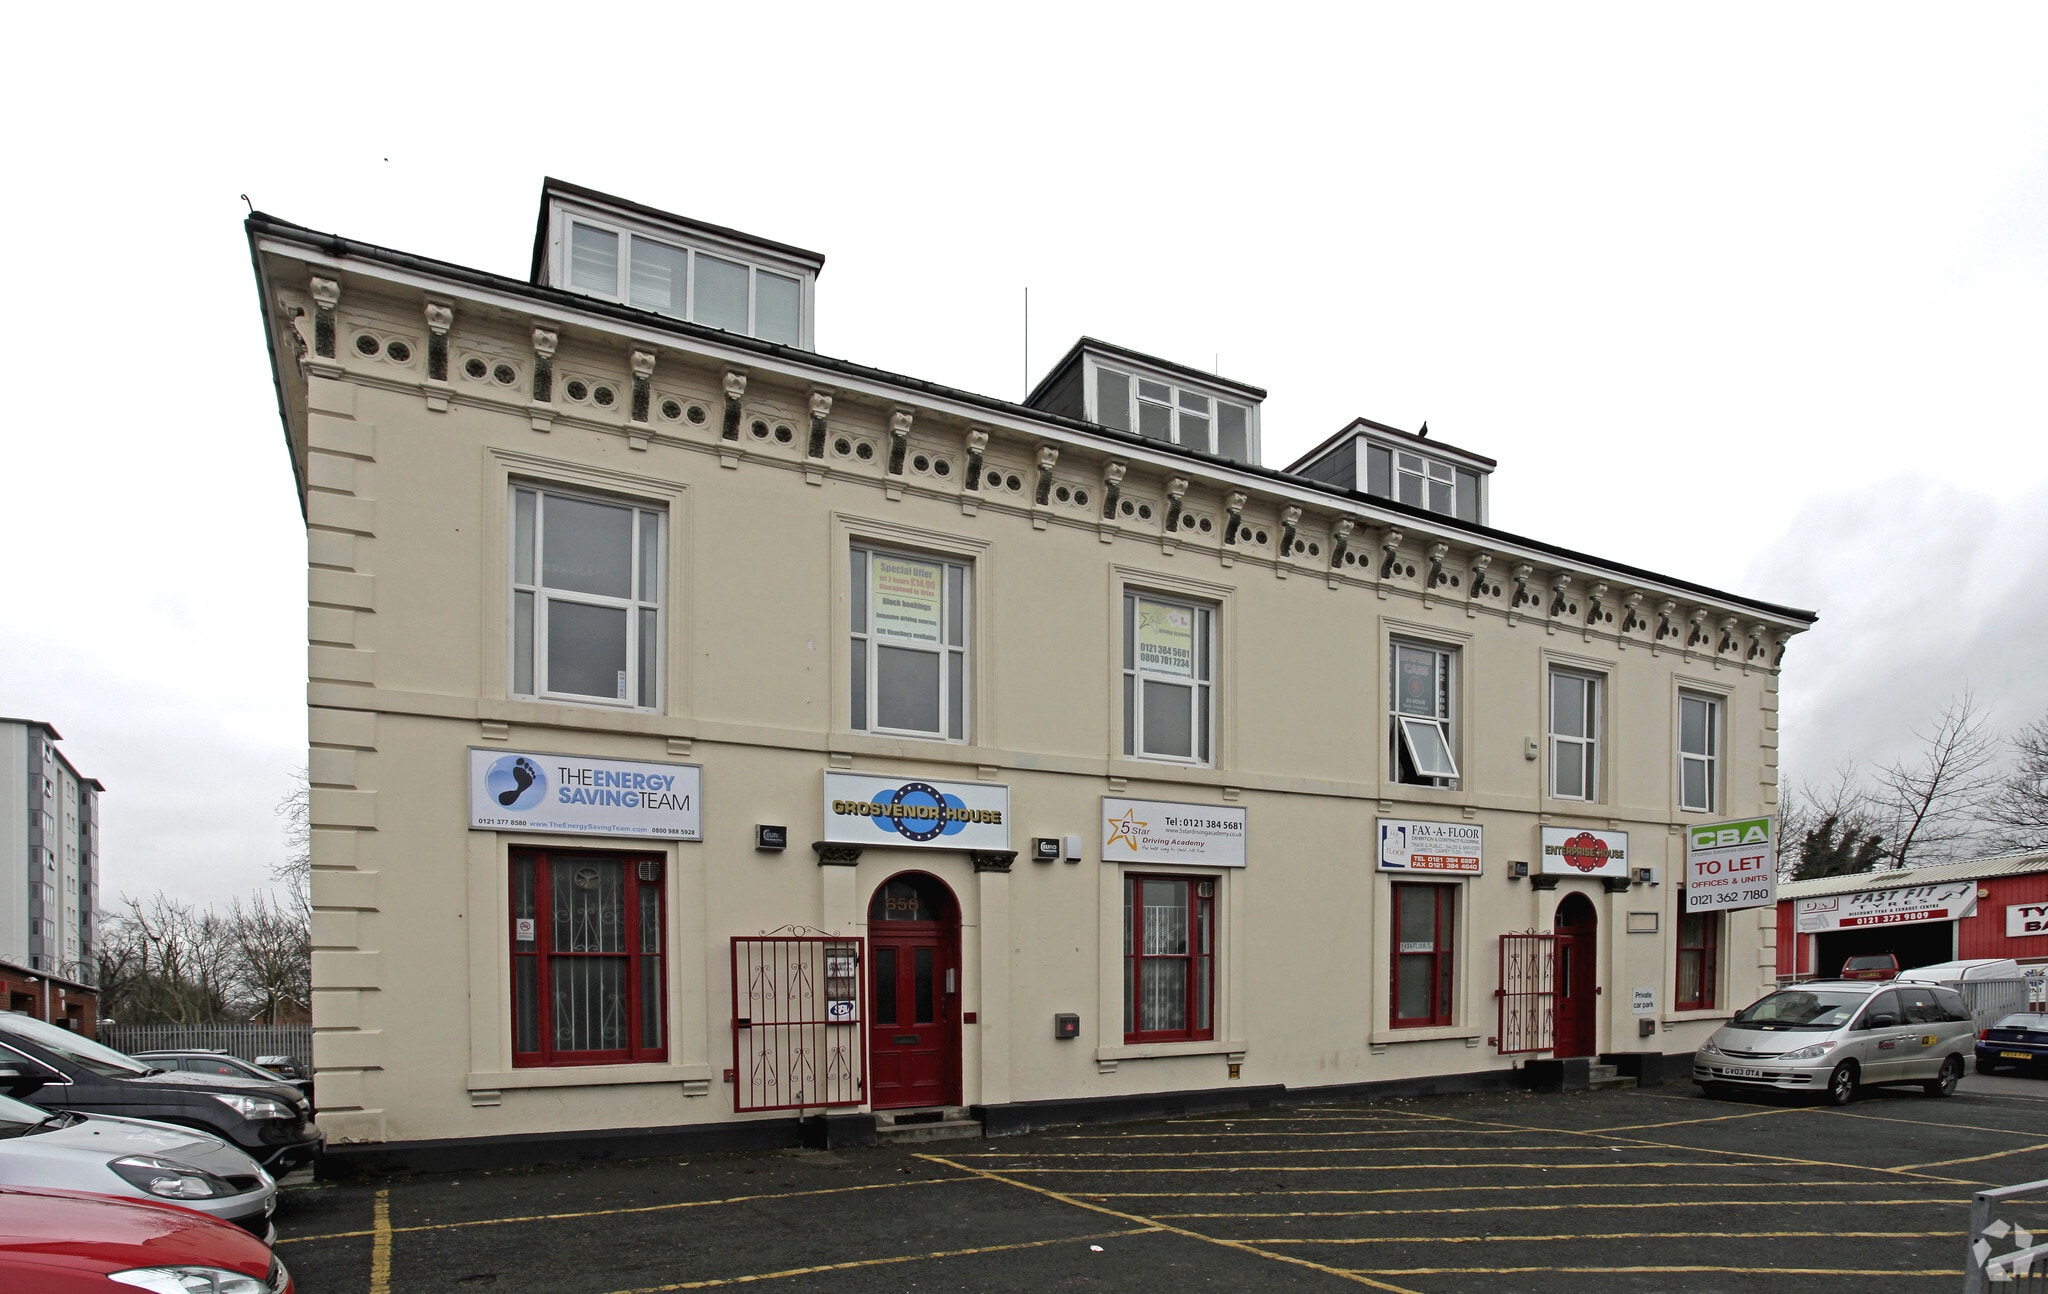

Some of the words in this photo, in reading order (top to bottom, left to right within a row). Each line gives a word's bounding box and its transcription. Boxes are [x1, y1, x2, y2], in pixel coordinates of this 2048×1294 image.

[881, 562, 911, 576] Special
[913, 567, 933, 579] Offer
[1140, 642, 1156, 652] 0121
[1158, 645, 1172, 655] 384
[832, 799, 941, 821] GROSVENOR
[945, 808, 1002, 825] HOUSE
[1120, 821, 1130, 835] 5
[1131, 826, 1151, 836] Star
[1183, 818, 1204, 828] 0121
[1206, 820, 1222, 829] 384
[1223, 821, 1243, 830] 5681
[1412, 824, 1430, 836] FAX
[1448, 827, 1479, 839] FLOOR
[1142, 837, 1170, 846] Driving
[1170, 838, 1206, 848] Academy
[1692, 826, 1768, 849] CBA
[1544, 845, 1594, 858] ENTERPRISE
[1597, 849, 1624, 860] HOUSE
[1695, 860, 1722, 876] TO
[1728, 855, 1765, 872] LET
[1691, 878, 1728, 889] OFFICES
[1740, 874, 1768, 884] UNITS
[1690, 894, 1712, 906] 0121
[1716, 892, 1738, 904] 362
[1742, 888, 1769, 901] 7180
[1850, 890, 1899, 905] FAST
[1904, 886, 1938, 899] FIT
[1856, 916, 1879, 926] 0121
[1883, 914, 1901, 923] 373
[1904, 911, 1929, 921] 9809
[1642, 1001, 1654, 1009] park
